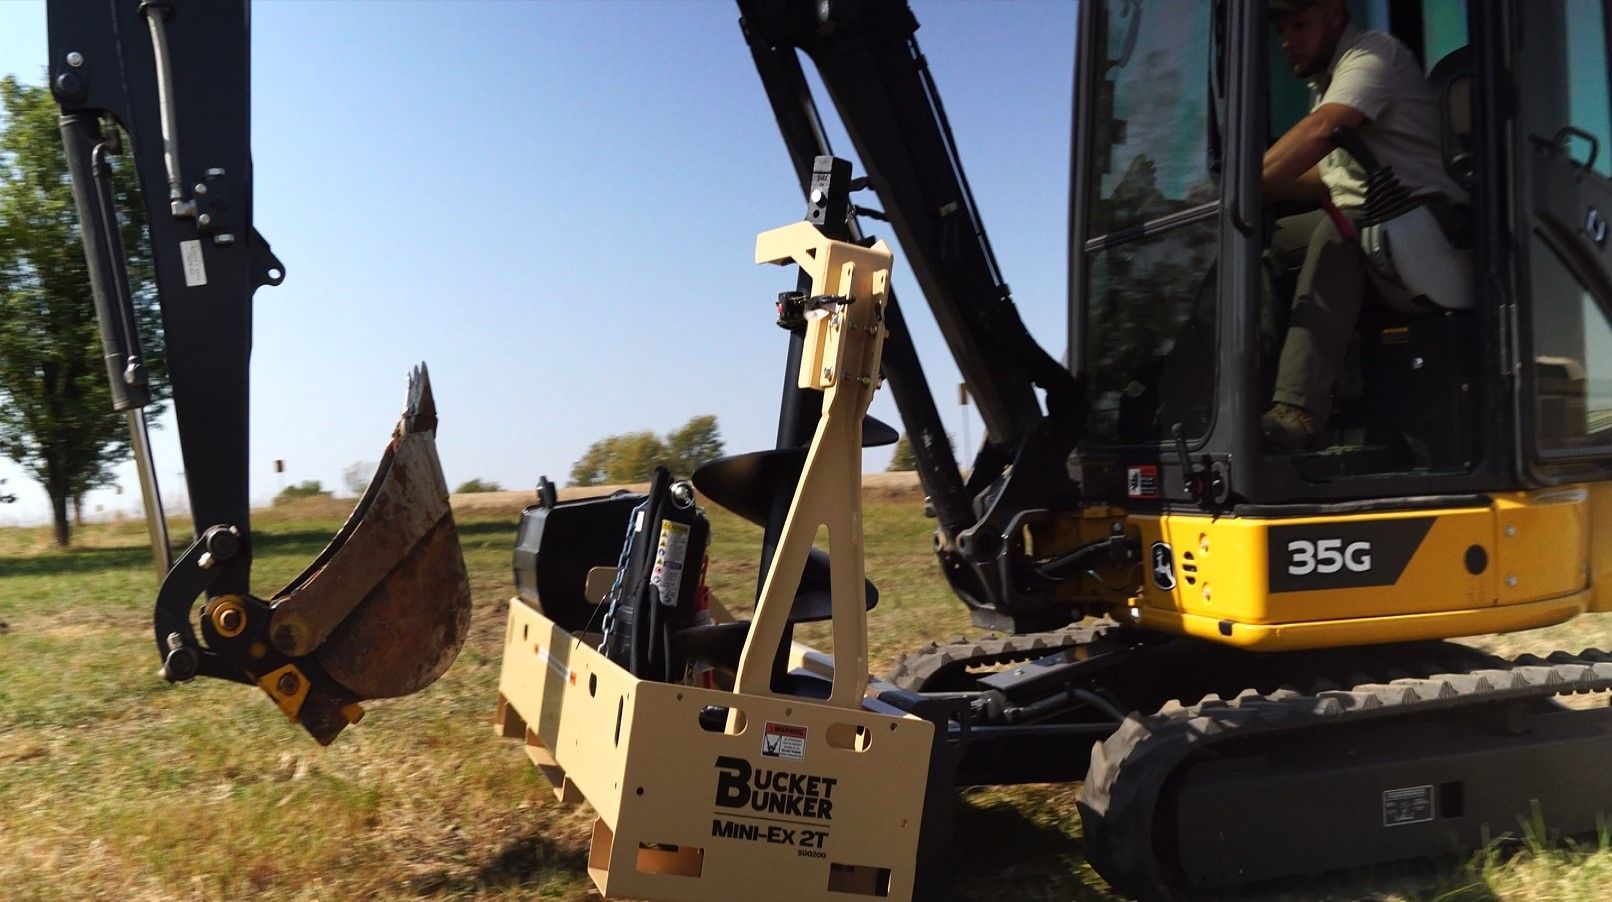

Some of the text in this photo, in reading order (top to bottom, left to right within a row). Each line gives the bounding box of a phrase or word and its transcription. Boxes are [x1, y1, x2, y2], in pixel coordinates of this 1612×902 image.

[1288, 539, 1371, 576] 35G
[715, 756, 837, 808] BUCKET
[712, 820, 829, 848] MINI-EX 2T
[797, 849, 827, 858] 500200
